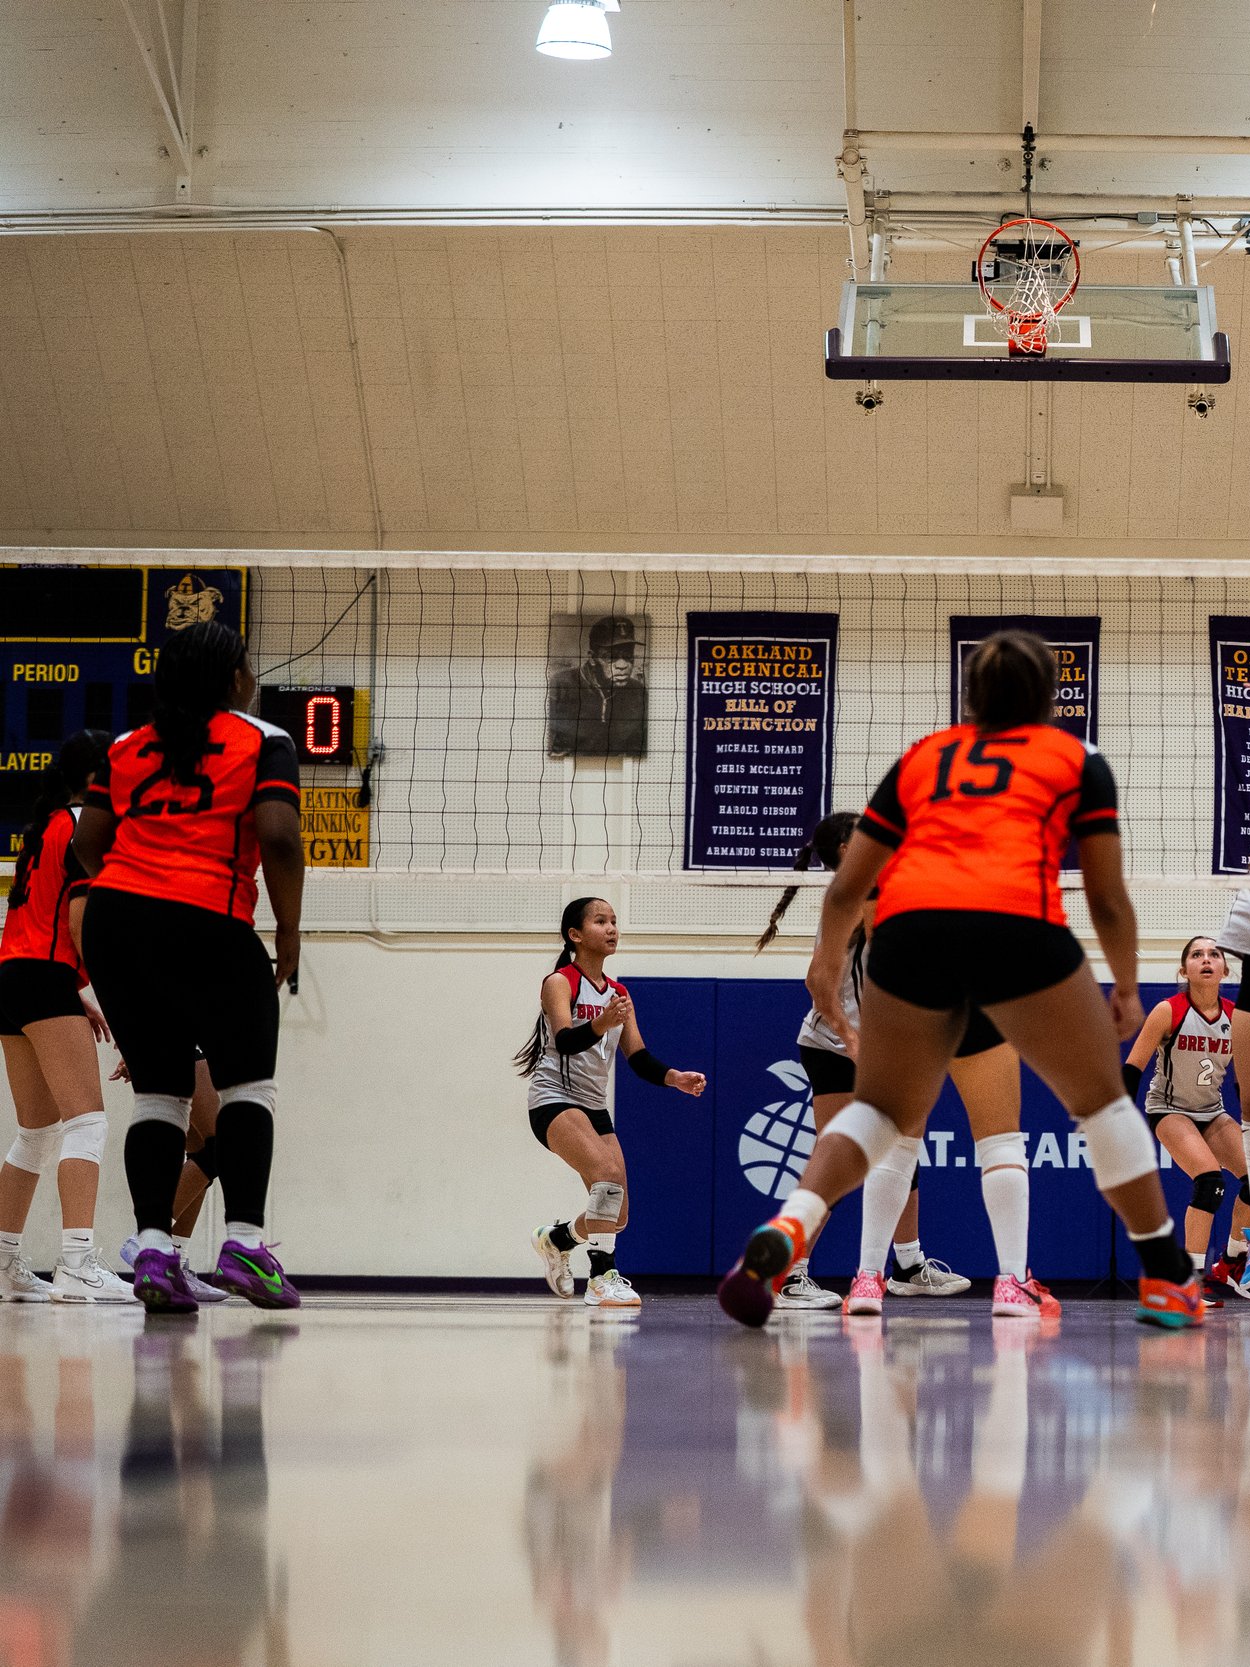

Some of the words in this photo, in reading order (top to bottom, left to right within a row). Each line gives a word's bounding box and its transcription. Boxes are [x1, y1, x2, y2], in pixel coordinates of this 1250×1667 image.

[711, 645, 813, 660] OAKLAND
[12, 663, 80, 682] PERIOD
[701, 662, 823, 678] TECHNICAL
[701, 681, 747, 694] HIGH
[750, 682, 821, 695] SCHOOL
[725, 699, 769, 712] HALL
[773, 700, 797, 713] OF
[1053, 705, 1086, 717] NOR
[306, 697, 340, 754] 0
[703, 717, 817, 732] DISTINCTION
[716, 744, 760, 753] MICHAEL
[764, 745, 804, 754] DENARD
[0, 752, 53, 771] LAYER
[716, 764, 745, 773] CHRIS
[750, 765, 802, 775] MCCLARTY
[930, 737, 1029, 803] 15
[714, 785, 759, 795] QUENTIN
[764, 786, 804, 795] THOMAS
[719, 805, 758, 815] HAROLD
[763, 806, 797, 816] GIBSON
[712, 826, 755, 835] VIRDELL
[760, 827, 804, 836] LARKINS
[309, 838, 363, 860] GYM
[706, 847, 756, 856] ARMANDO
[760, 848, 800, 857] SURRAT
[1178, 1034, 1232, 1054] BREWE
[1197, 1058, 1214, 1086] 2
